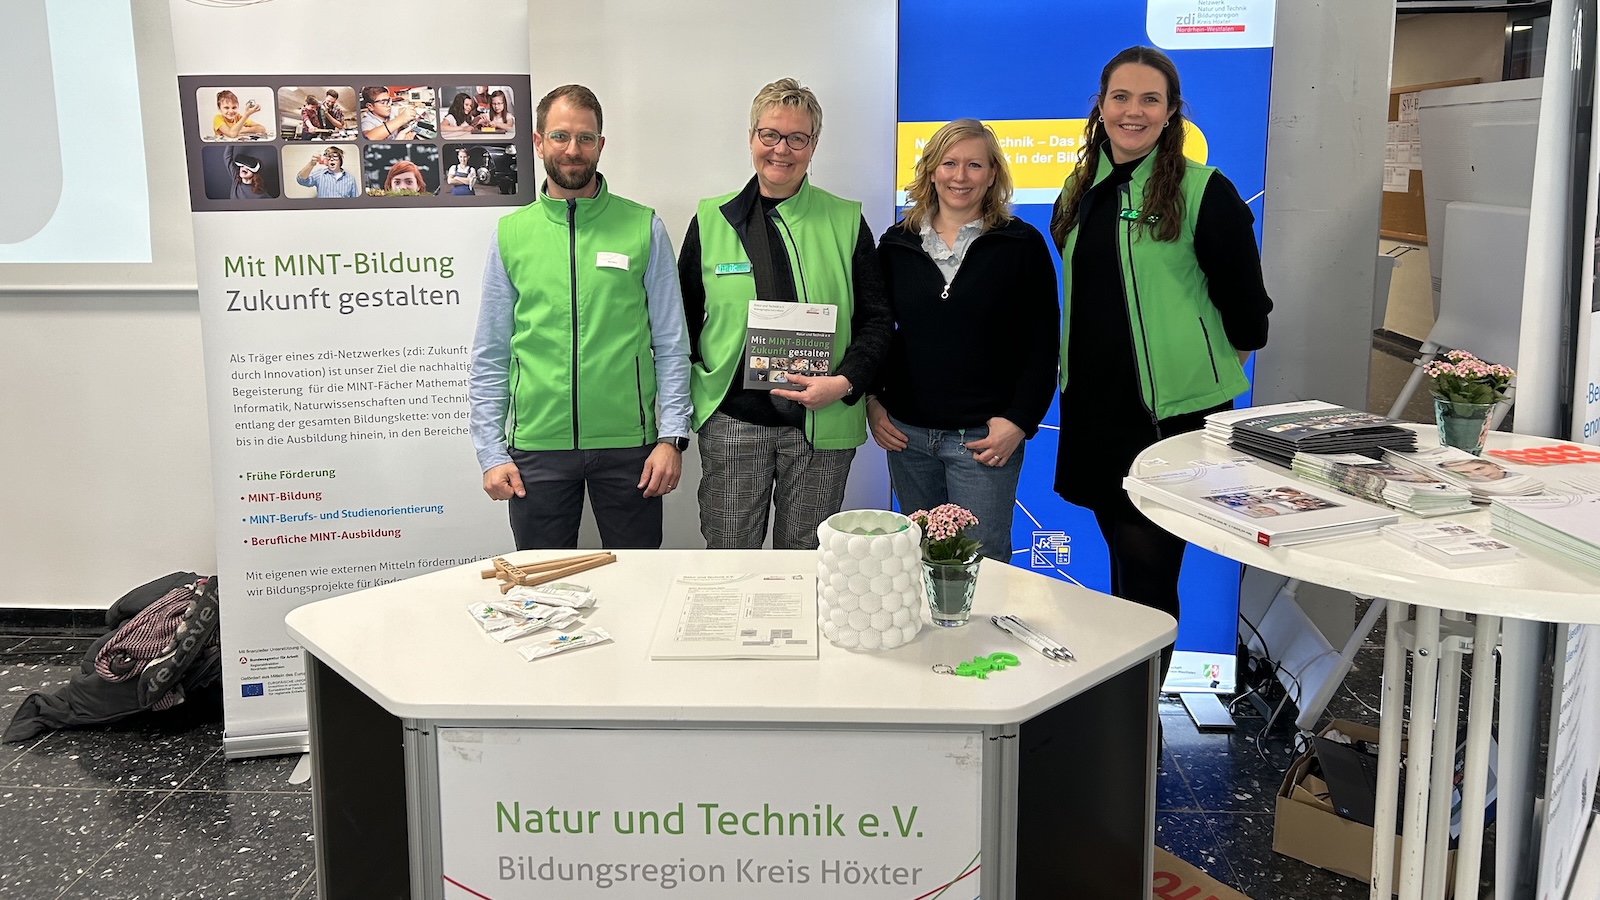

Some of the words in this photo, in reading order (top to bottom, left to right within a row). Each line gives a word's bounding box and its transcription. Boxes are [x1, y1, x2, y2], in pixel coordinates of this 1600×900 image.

[1176, 13, 1195, 25] zdi
[1050, 136, 1074, 147] Das
[1016, 152, 1027, 163] in
[1031, 152, 1052, 163] der
[225, 256, 266, 278] Mit
[275, 252, 454, 278] MINT-Bildung
[226, 288, 331, 312] Zukunft
[339, 284, 460, 315] gestalten
[751, 336, 766, 345] Mit
[768, 337, 830, 349] MINT-Bildung
[230, 354, 246, 363] Als
[248, 353, 282, 365] Träger
[286, 352, 315, 362] eines
[318, 348, 400, 360] zdi-Netzwerkes
[403, 346, 425, 358] (zdi:
[428, 345, 468, 355] Zukunft
[751, 346, 786, 355] Zukunft
[788, 348, 830, 358] gestalten
[231, 370, 261, 380] durch
[264, 367, 326, 379] Innovation)
[328, 367, 342, 376] ist
[377, 364, 397, 374] Ziel
[400, 363, 416, 372] die
[232, 386, 303, 399] Begeisterung
[308, 384, 324, 394] für
[327, 383, 344, 392] die
[347, 380, 413, 391] MINT-Fächer
[234, 402, 291, 413] Informatik,
[294, 397, 406, 411] Naturwissenschaften
[408, 395, 428, 404] und
[235, 420, 275, 431] entlang
[278, 419, 296, 428] der
[298, 418, 351, 430] gesamten
[354, 412, 429, 424] Bildungskette:
[454, 410, 470, 419] der
[236, 437, 252, 446] bis
[254, 436, 264, 446] in
[267, 436, 284, 445] die
[286, 433, 348, 444] Ausbildung
[350, 430, 386, 440] hinein,
[388, 429, 398, 438] in
[401, 428, 421, 438] den
[246, 471, 277, 481] Frühe
[280, 469, 336, 479] Förderung
[248, 491, 322, 502] MINT-Bildung
[250, 512, 317, 524] MINT-Berufs-
[320, 510, 339, 520] und
[341, 505, 444, 518] Studienorientierung
[252, 534, 307, 546] Berufliche
[310, 528, 401, 542] MINT-Ausbildung
[246, 571, 263, 580] Mit
[265, 570, 307, 581] eigenen
[310, 566, 328, 576] wie
[331, 565, 376, 574] externen
[380, 560, 415, 571] Mitteln
[418, 558, 455, 568] fördern
[458, 555, 476, 564] und
[246, 587, 263, 596] wir
[266, 581, 354, 595] Bildungsprojekte
[357, 579, 371, 588] für
[496, 802, 600, 834] Natur
[614, 802, 684, 835] und
[697, 804, 846, 838] Technik
[858, 806, 924, 838] e.V.
[499, 856, 726, 890] Bildungsregion
[736, 858, 810, 884] Kreis
[820, 860, 922, 886] Höxter
